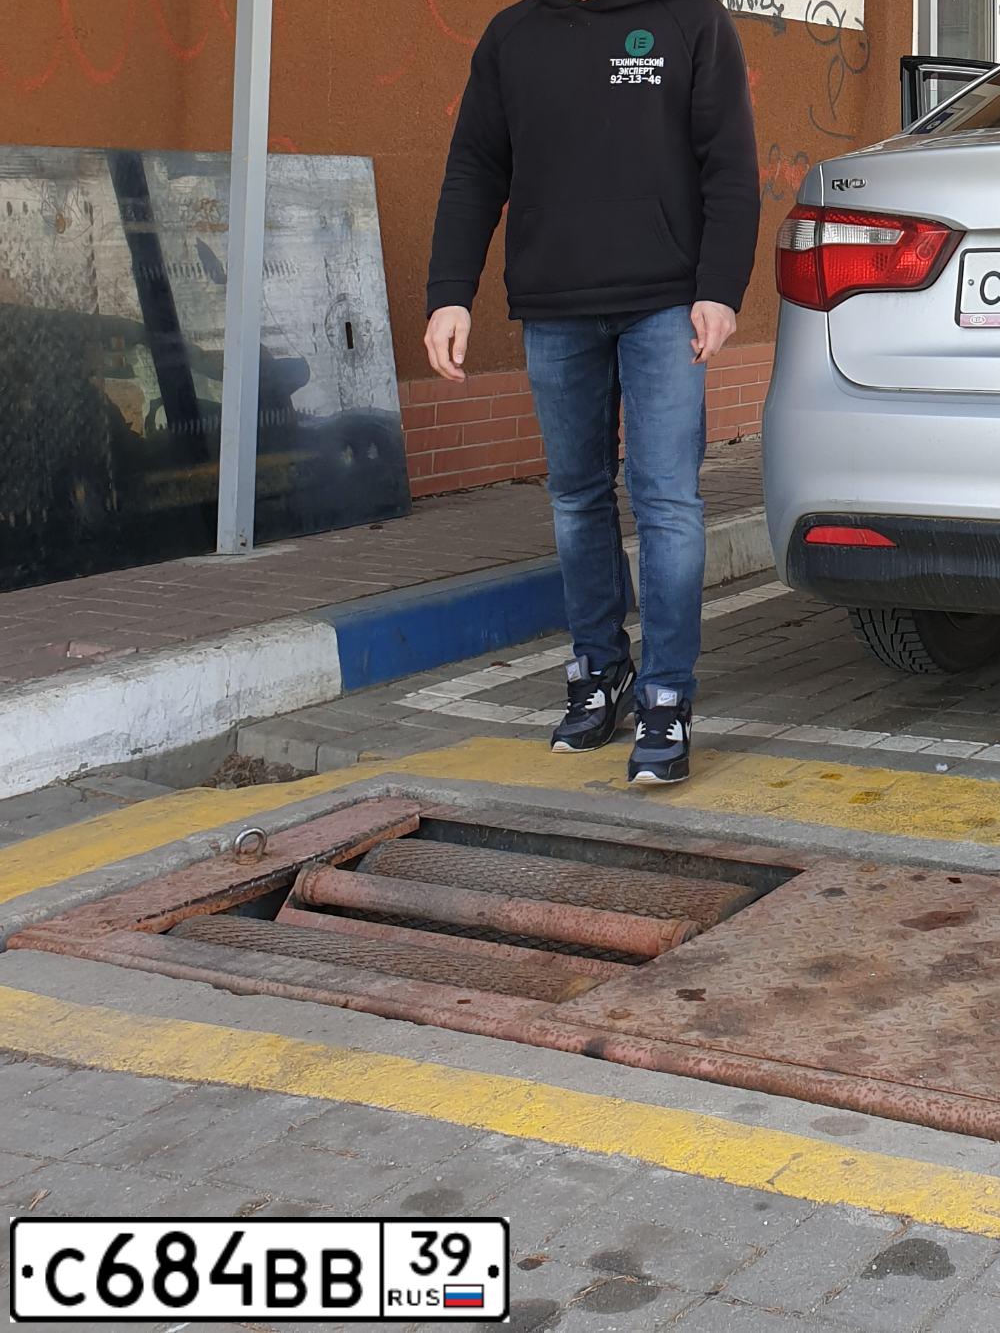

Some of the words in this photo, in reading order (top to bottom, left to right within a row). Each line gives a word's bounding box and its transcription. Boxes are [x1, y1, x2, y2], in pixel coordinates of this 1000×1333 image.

[610, 57, 665, 67] ТЕХНИЧЕСКИЙ
[618, 67, 655, 75] ЭКСПЕРТ
[610, 74, 662, 85] 92-13-46
[832, 178, 867, 191] RIO
